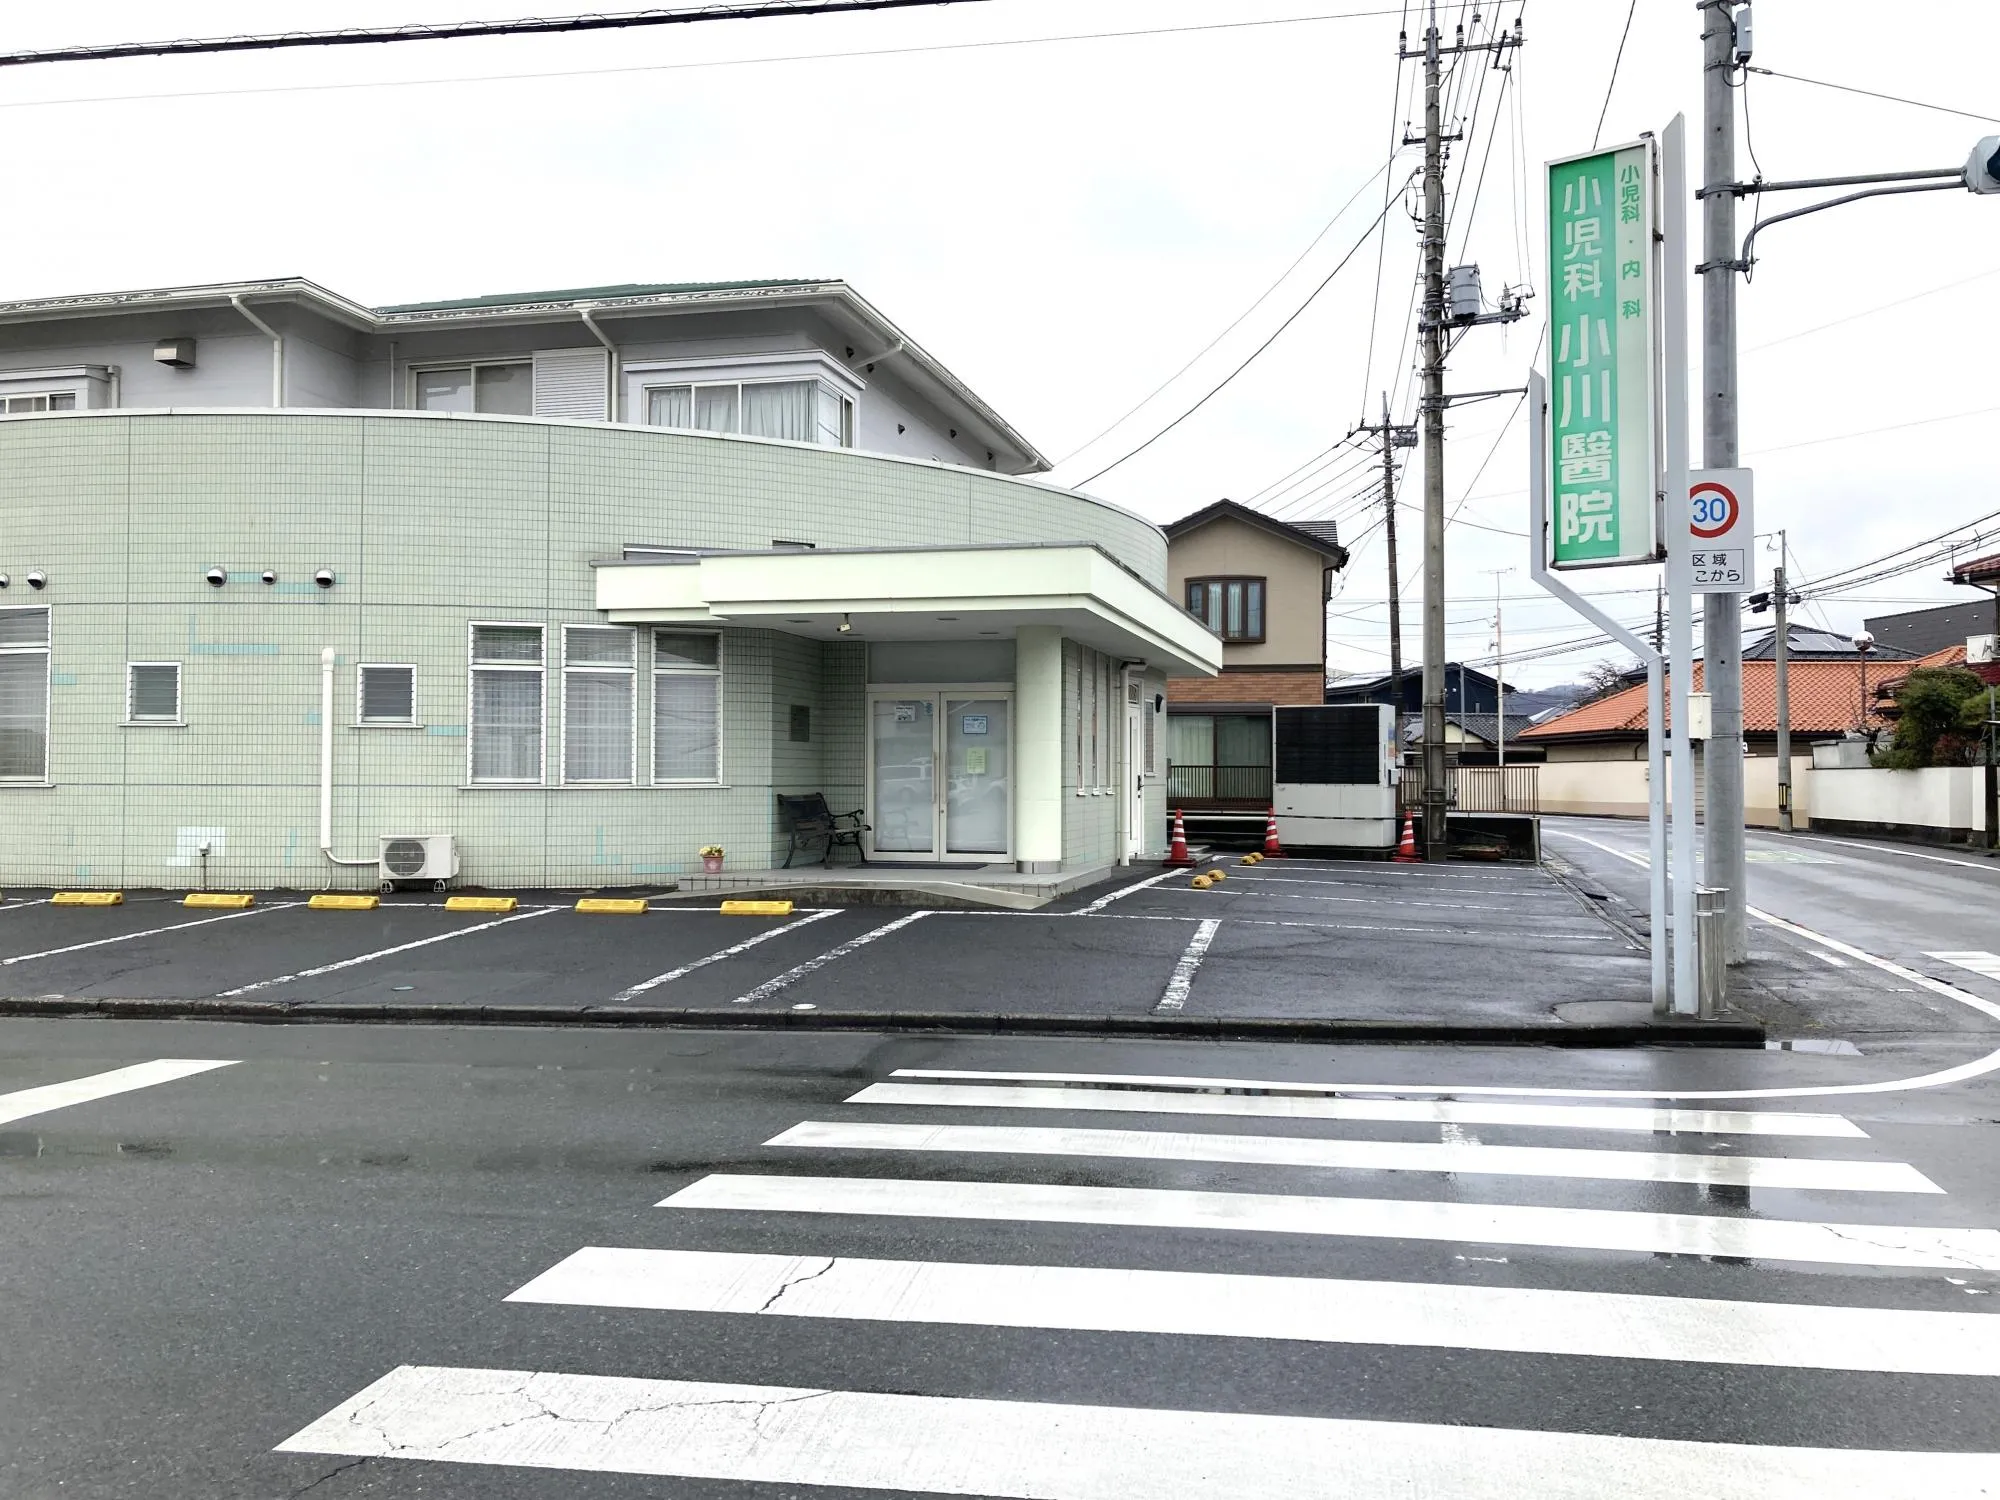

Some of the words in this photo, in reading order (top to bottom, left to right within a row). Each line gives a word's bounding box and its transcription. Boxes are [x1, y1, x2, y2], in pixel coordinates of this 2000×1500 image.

[1562, 175, 1604, 304] 小児科
[1559, 313, 1614, 547] 小川醫院
[1692, 498, 1726, 523] 30
[1692, 553, 1727, 567] 区域
